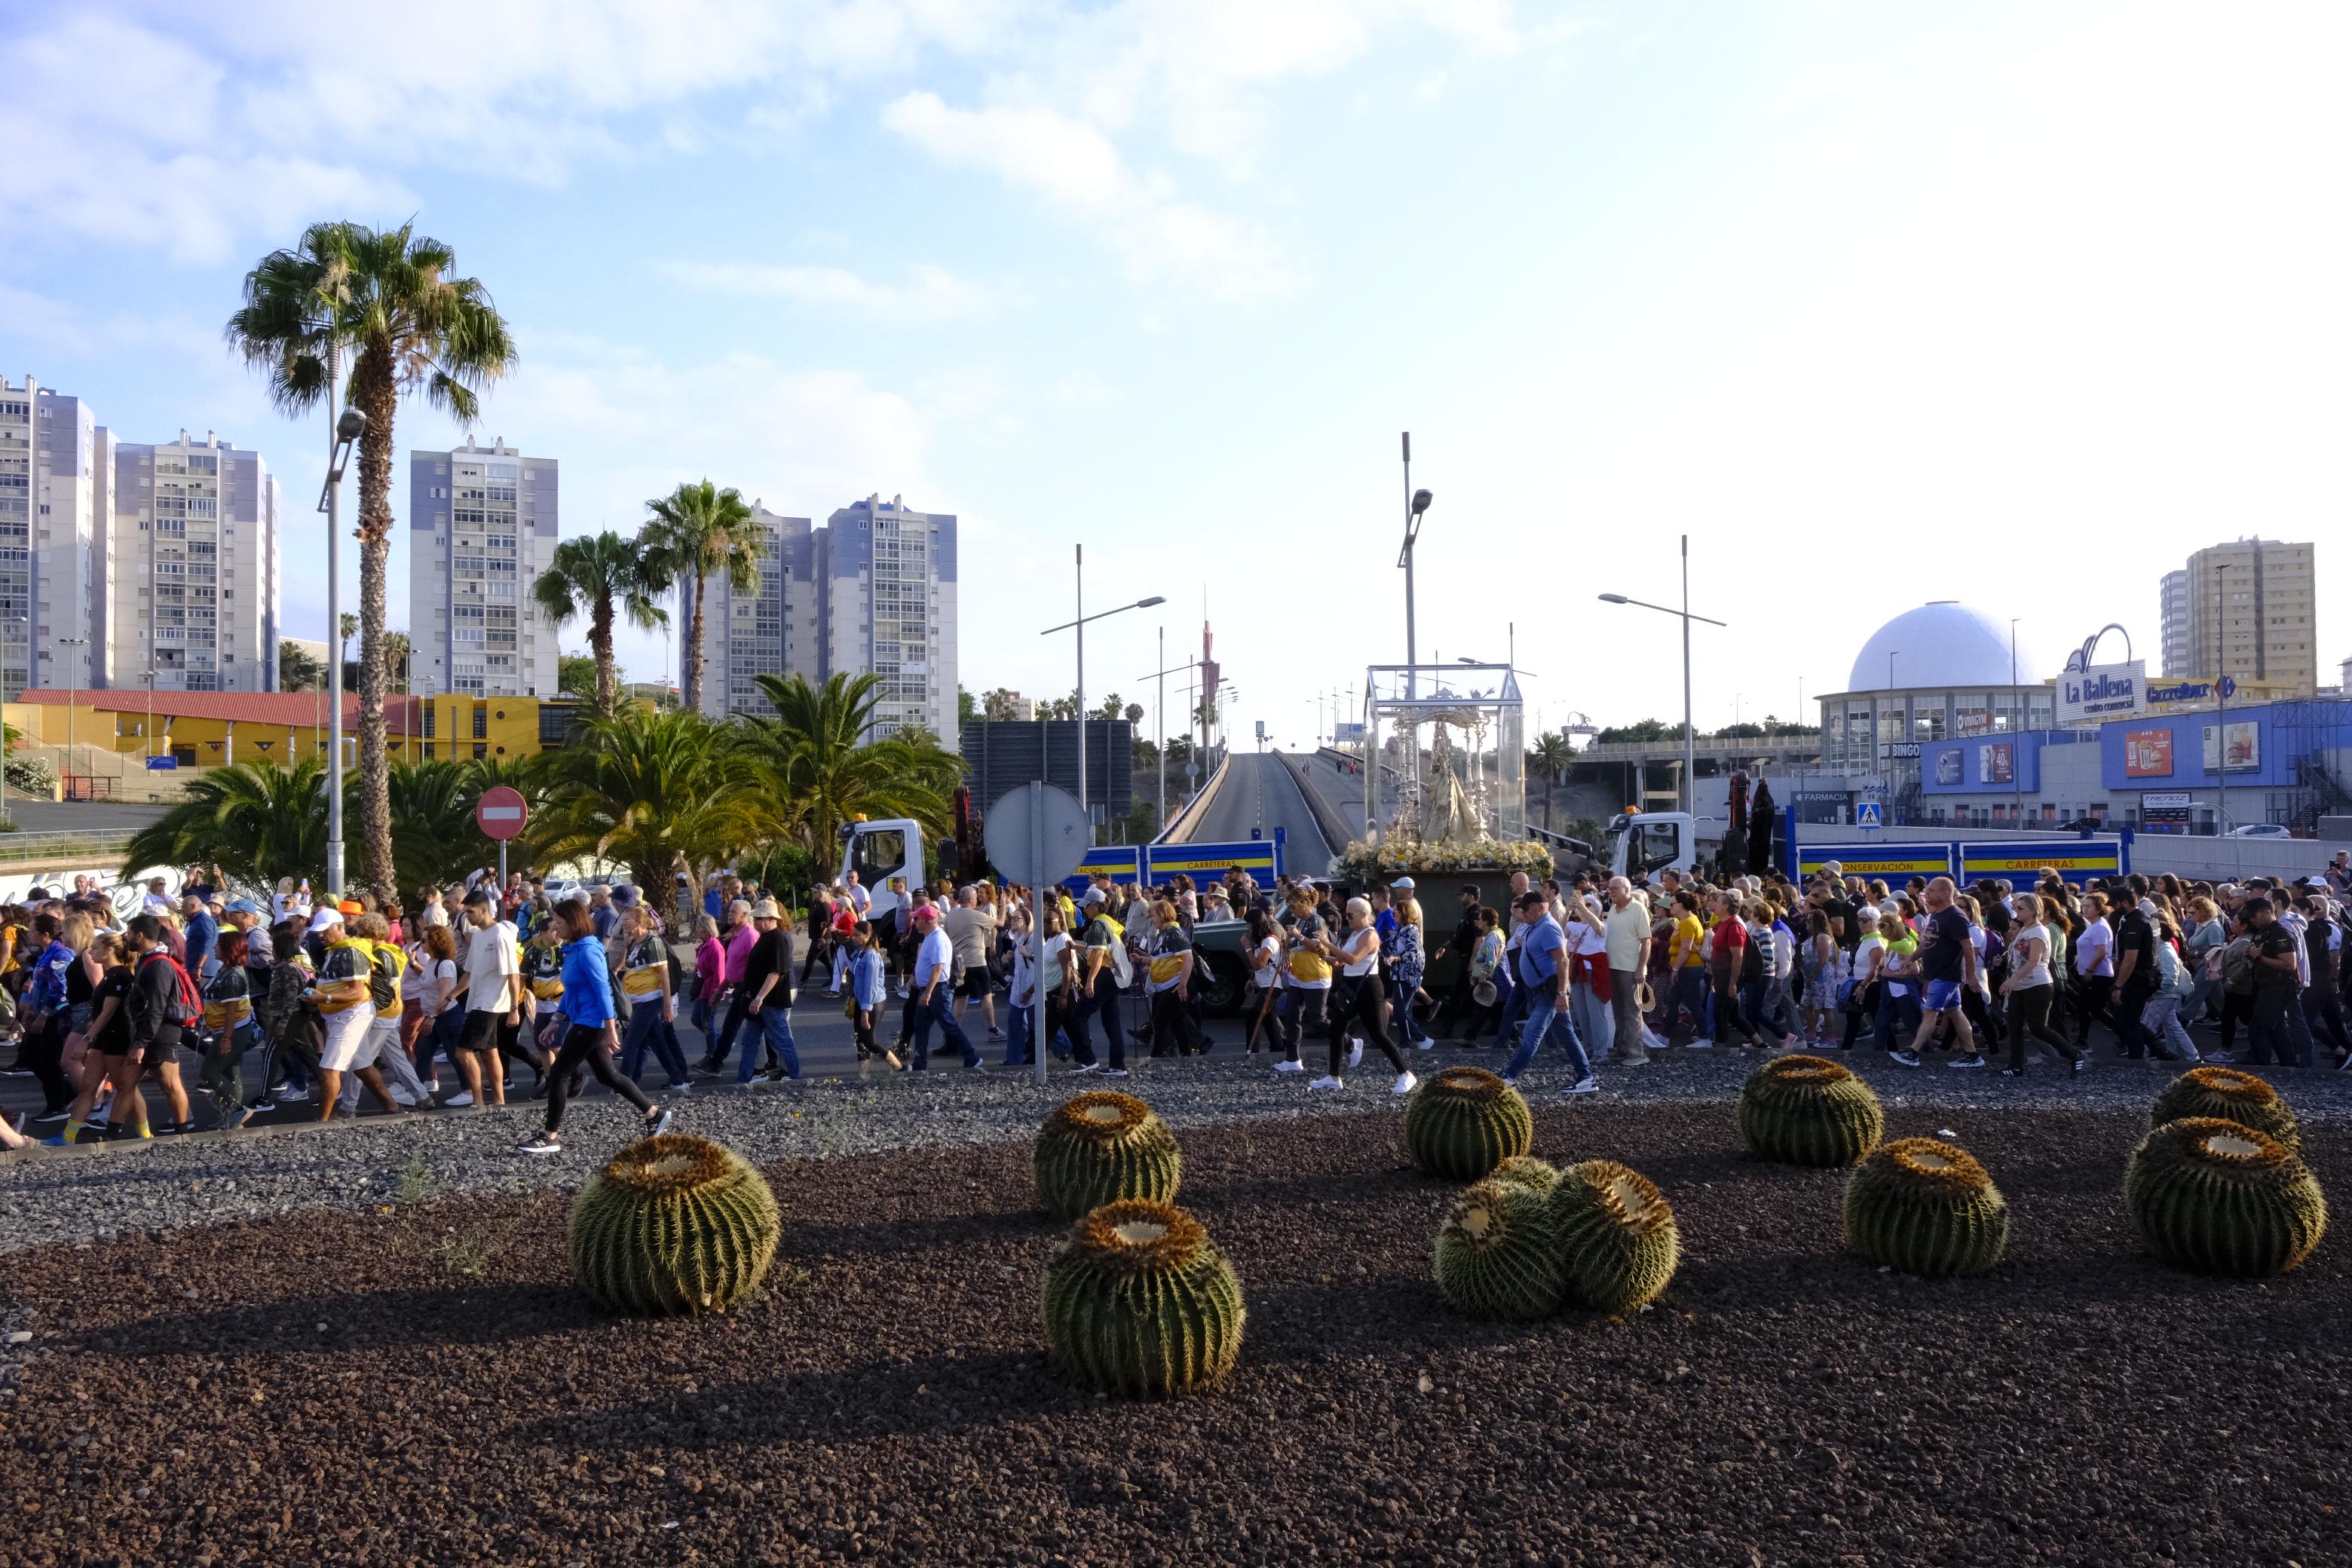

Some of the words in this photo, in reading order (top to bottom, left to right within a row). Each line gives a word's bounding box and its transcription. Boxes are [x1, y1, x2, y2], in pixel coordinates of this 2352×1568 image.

[2066, 681, 2080, 704] La
[2083, 673, 2133, 701] Ballena
[2147, 681, 2210, 703] Carrefour
[2084, 703, 2103, 714] centro
[2104, 696, 2134, 712] comercial
[1893, 743, 1920, 756] BINGO
[1187, 860, 1236, 869] CARRETERAS
[1842, 862, 1913, 872] ONSERVACIÓN
[2006, 859, 2075, 870] CARRETERAS
